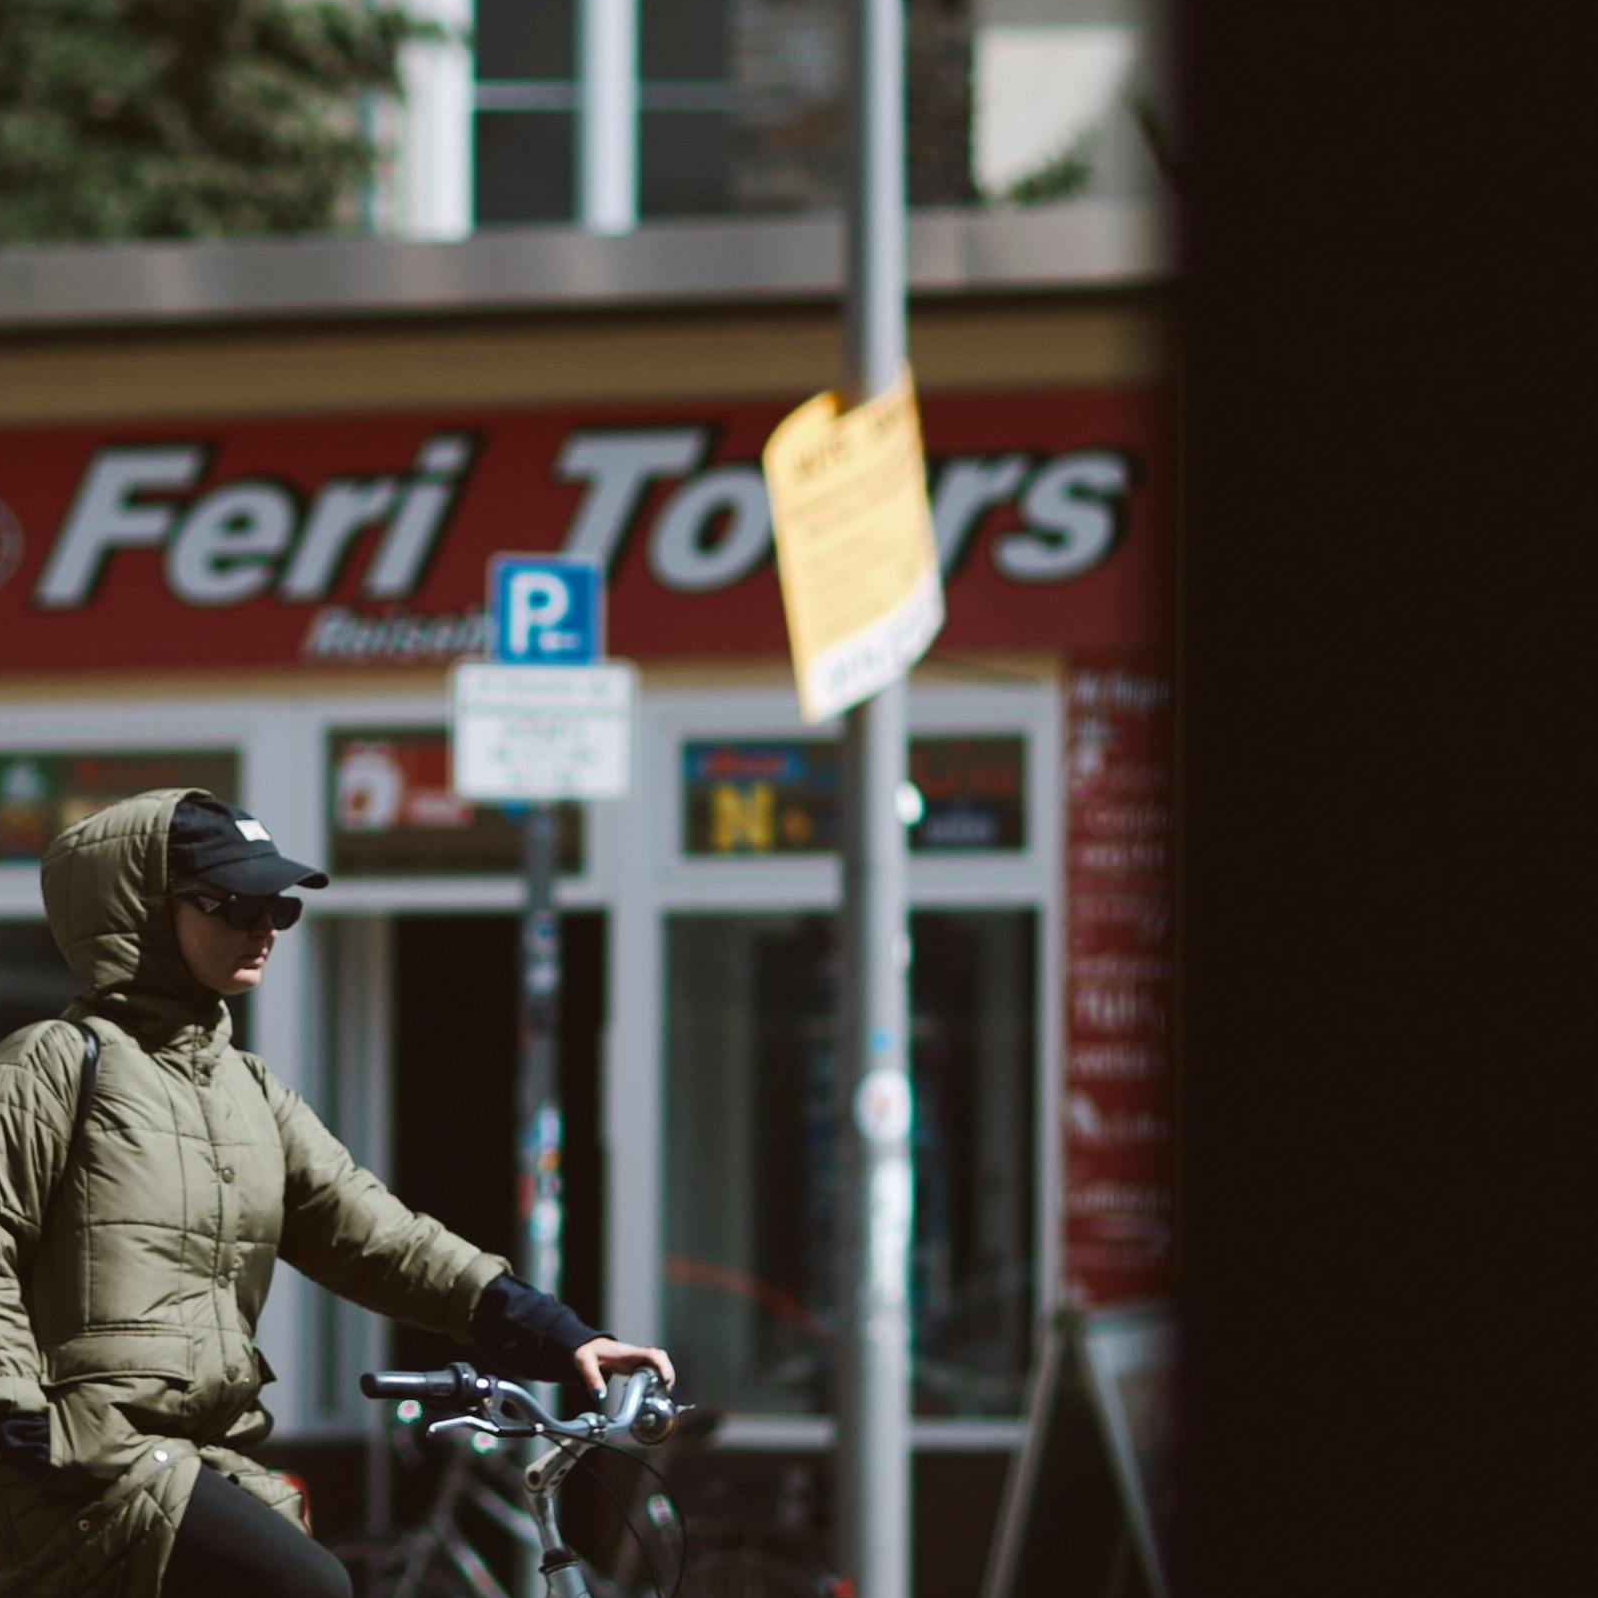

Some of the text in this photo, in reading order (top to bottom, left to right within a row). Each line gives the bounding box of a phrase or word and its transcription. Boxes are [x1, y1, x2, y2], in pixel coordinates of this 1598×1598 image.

[36, 434, 474, 605] Feri
[554, 427, 1129, 592] Tors
[509, 570, 570, 654] P
